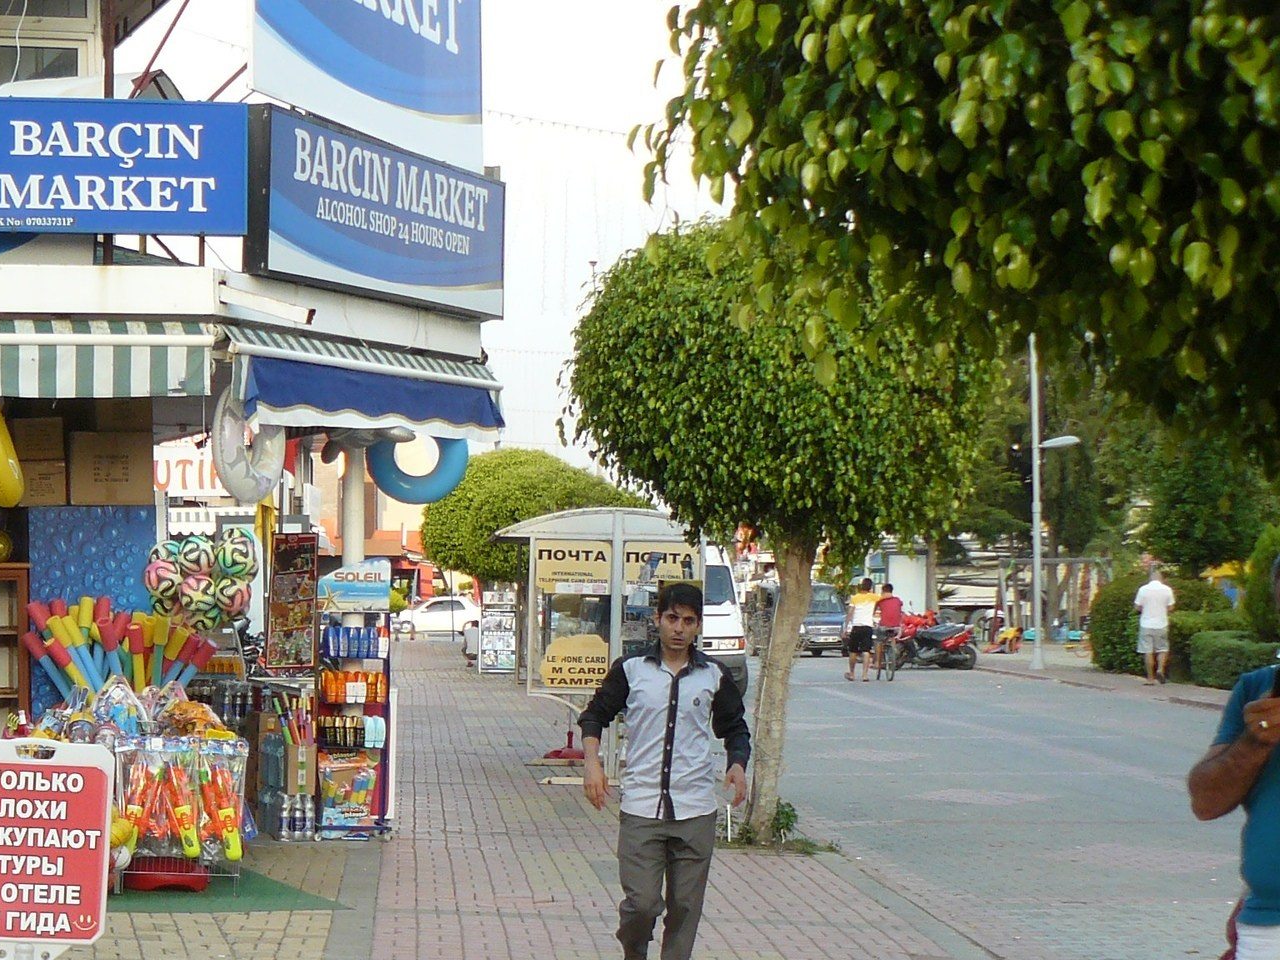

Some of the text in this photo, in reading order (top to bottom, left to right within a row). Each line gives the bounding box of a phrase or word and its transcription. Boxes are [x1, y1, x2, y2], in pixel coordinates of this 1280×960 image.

[9, 120, 204, 168] BARÇIN
[293, 127, 489, 232] BARCIN MARKET
[25, 217, 74, 226] 07033731P
[316, 197, 471, 256] ALCOHOL SHOP 24 HOURS OPEN
[538, 549, 608, 562] ПОЧТА
[334, 571, 386, 583] SOLEIL
[585, 656, 606, 664] CARD
[568, 667, 607, 675] CARD
[0, 882, 81, 905] ОТЕЛЕ
[5, 911, 72, 936] ГИДА
